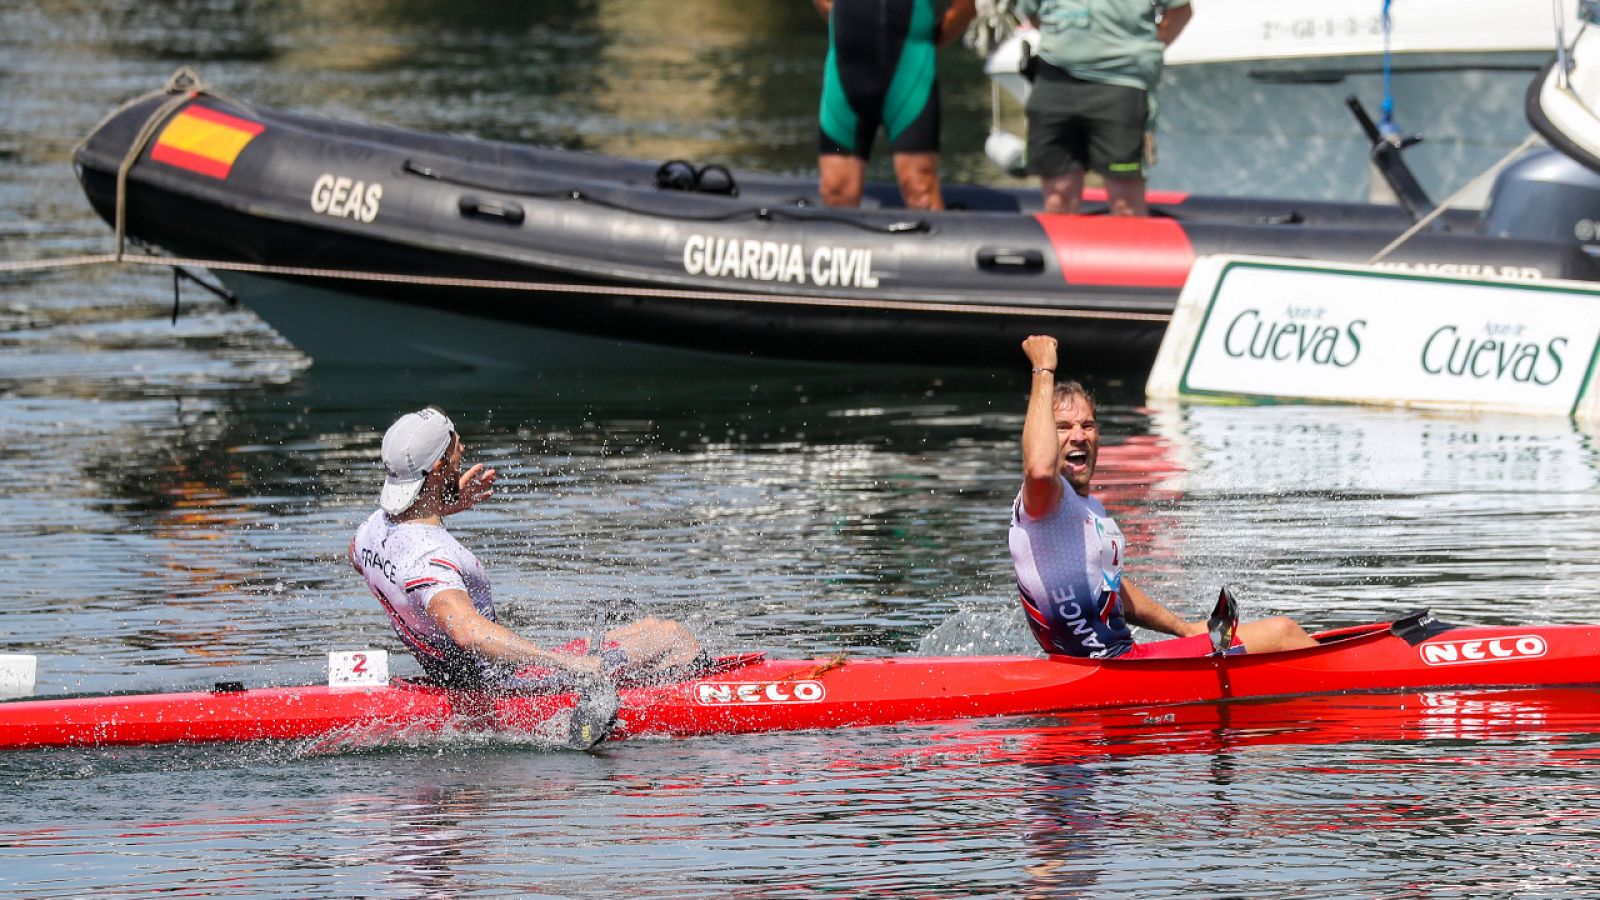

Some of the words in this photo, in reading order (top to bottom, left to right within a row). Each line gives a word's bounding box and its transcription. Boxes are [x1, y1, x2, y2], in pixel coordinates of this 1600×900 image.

[310, 173, 383, 223] GEAS
[683, 234, 806, 285] GUARDIA
[811, 246, 880, 288] CIVIL
[361, 547, 397, 585] FRACE
[1051, 584, 1106, 660] RANCE
[352, 653, 368, 673] 2
[1425, 637, 1544, 663] NELO
[699, 683, 823, 702] NELO
